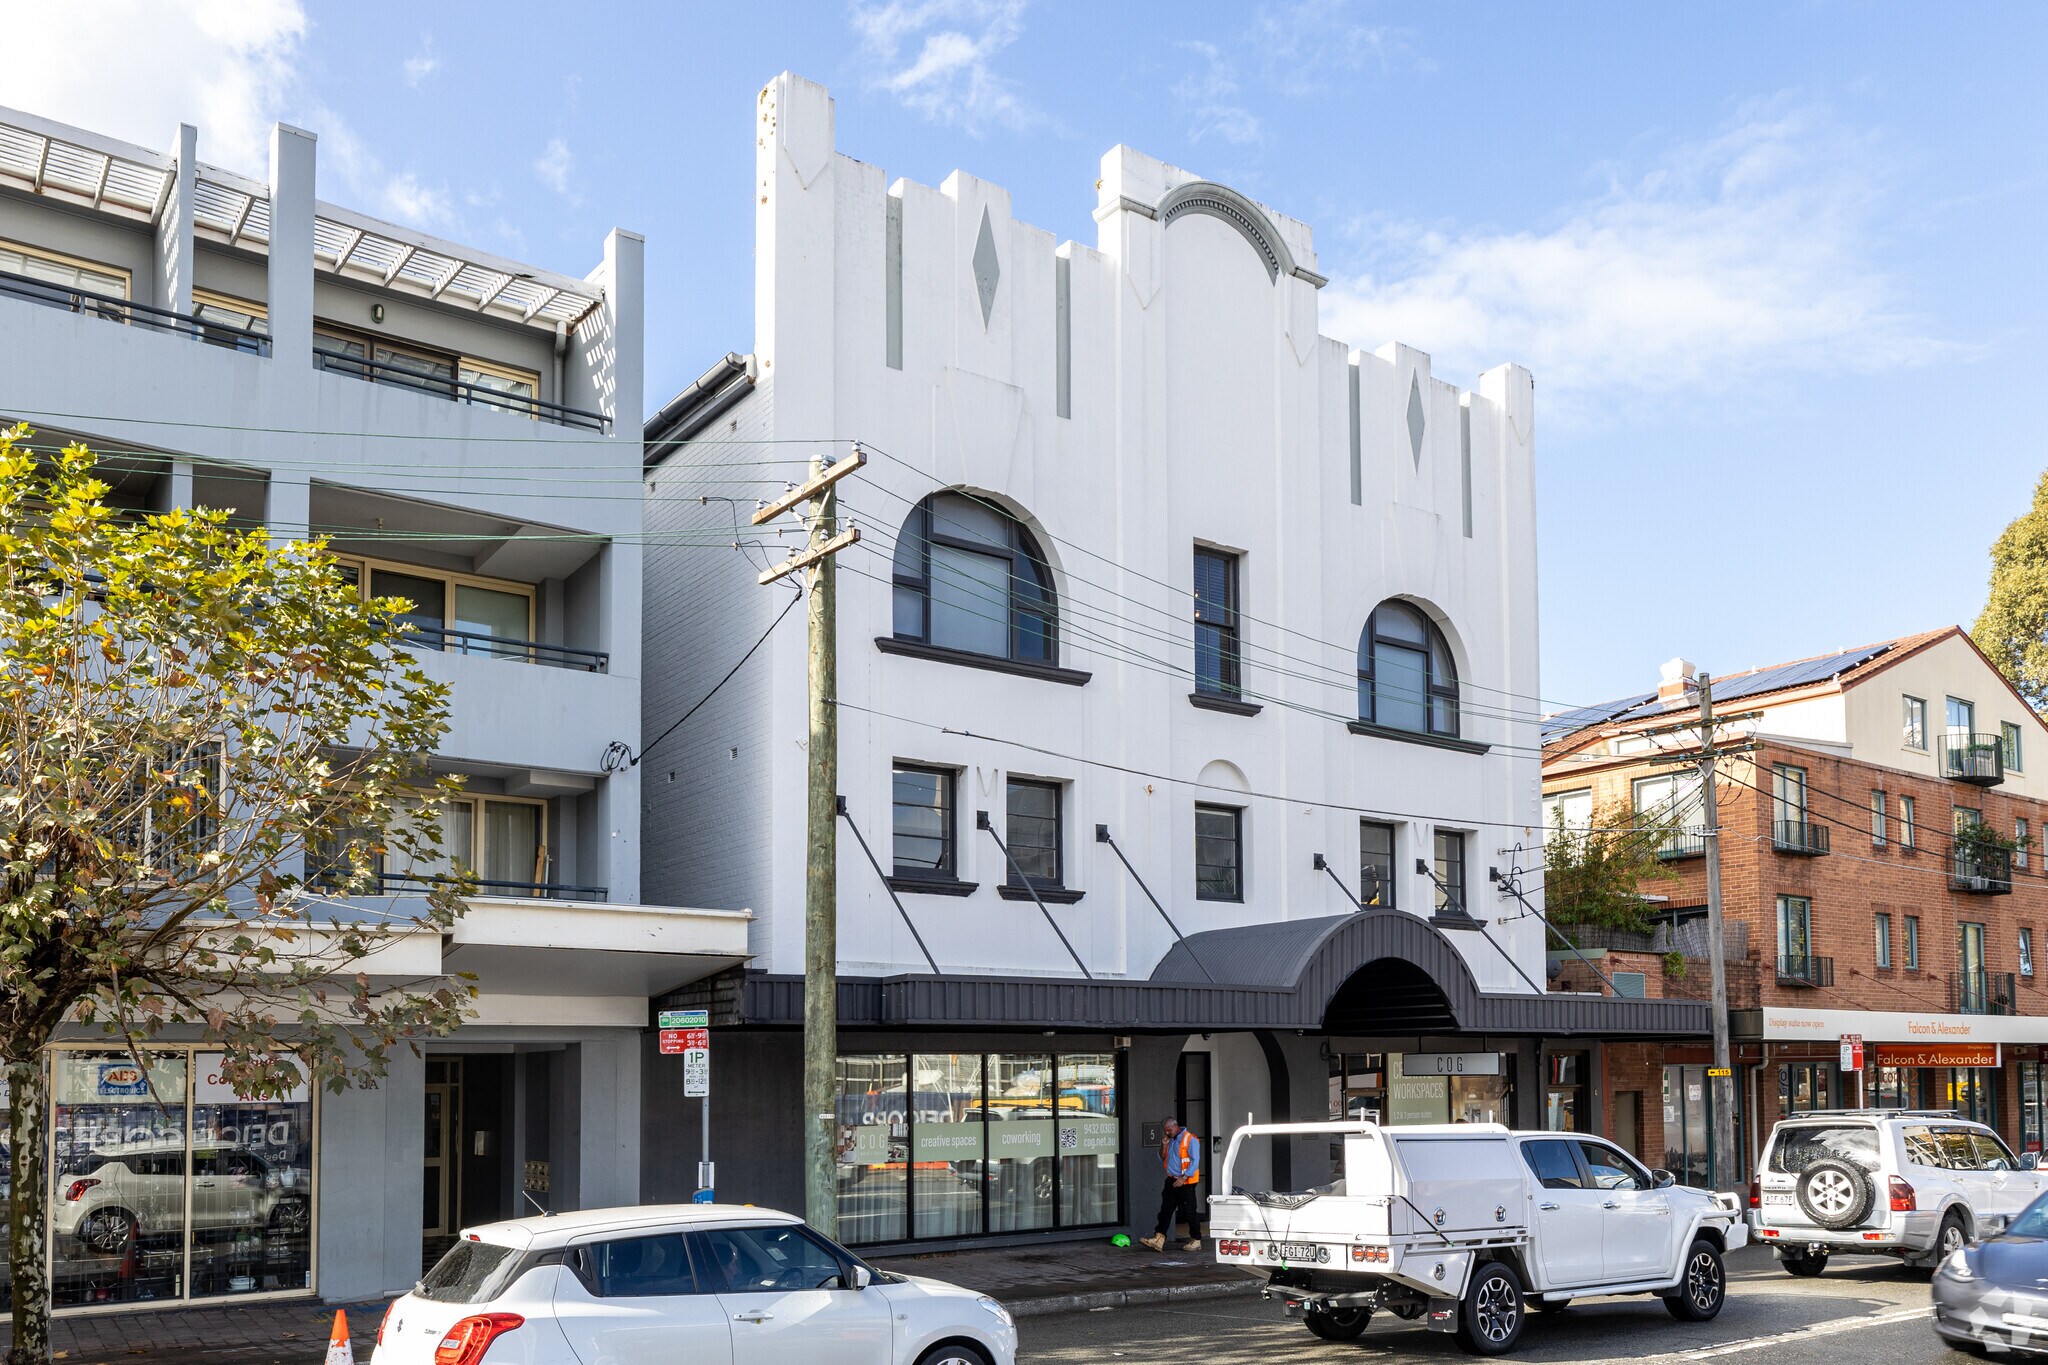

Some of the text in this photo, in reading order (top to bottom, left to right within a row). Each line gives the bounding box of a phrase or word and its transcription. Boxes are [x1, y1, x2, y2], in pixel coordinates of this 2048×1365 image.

[671, 1016, 706, 1024] 20602010
[1768, 1018, 1788, 1028] Display
[1908, 1020, 1971, 1034] Falcon & Alexander
[689, 1051, 705, 1064] 1P
[1876, 1052, 1994, 1065] Falcon & Alexander
[1393, 1082, 1444, 1099] WORKSPACES
[1083, 1123, 1115, 1135] 9432 0303
[1150, 1129, 1155, 1140] 5
[921, 1135, 977, 1149] creative spaces
[1002, 1130, 1041, 1146] coworking
[1083, 1136, 1116, 1149] cog.net.au
